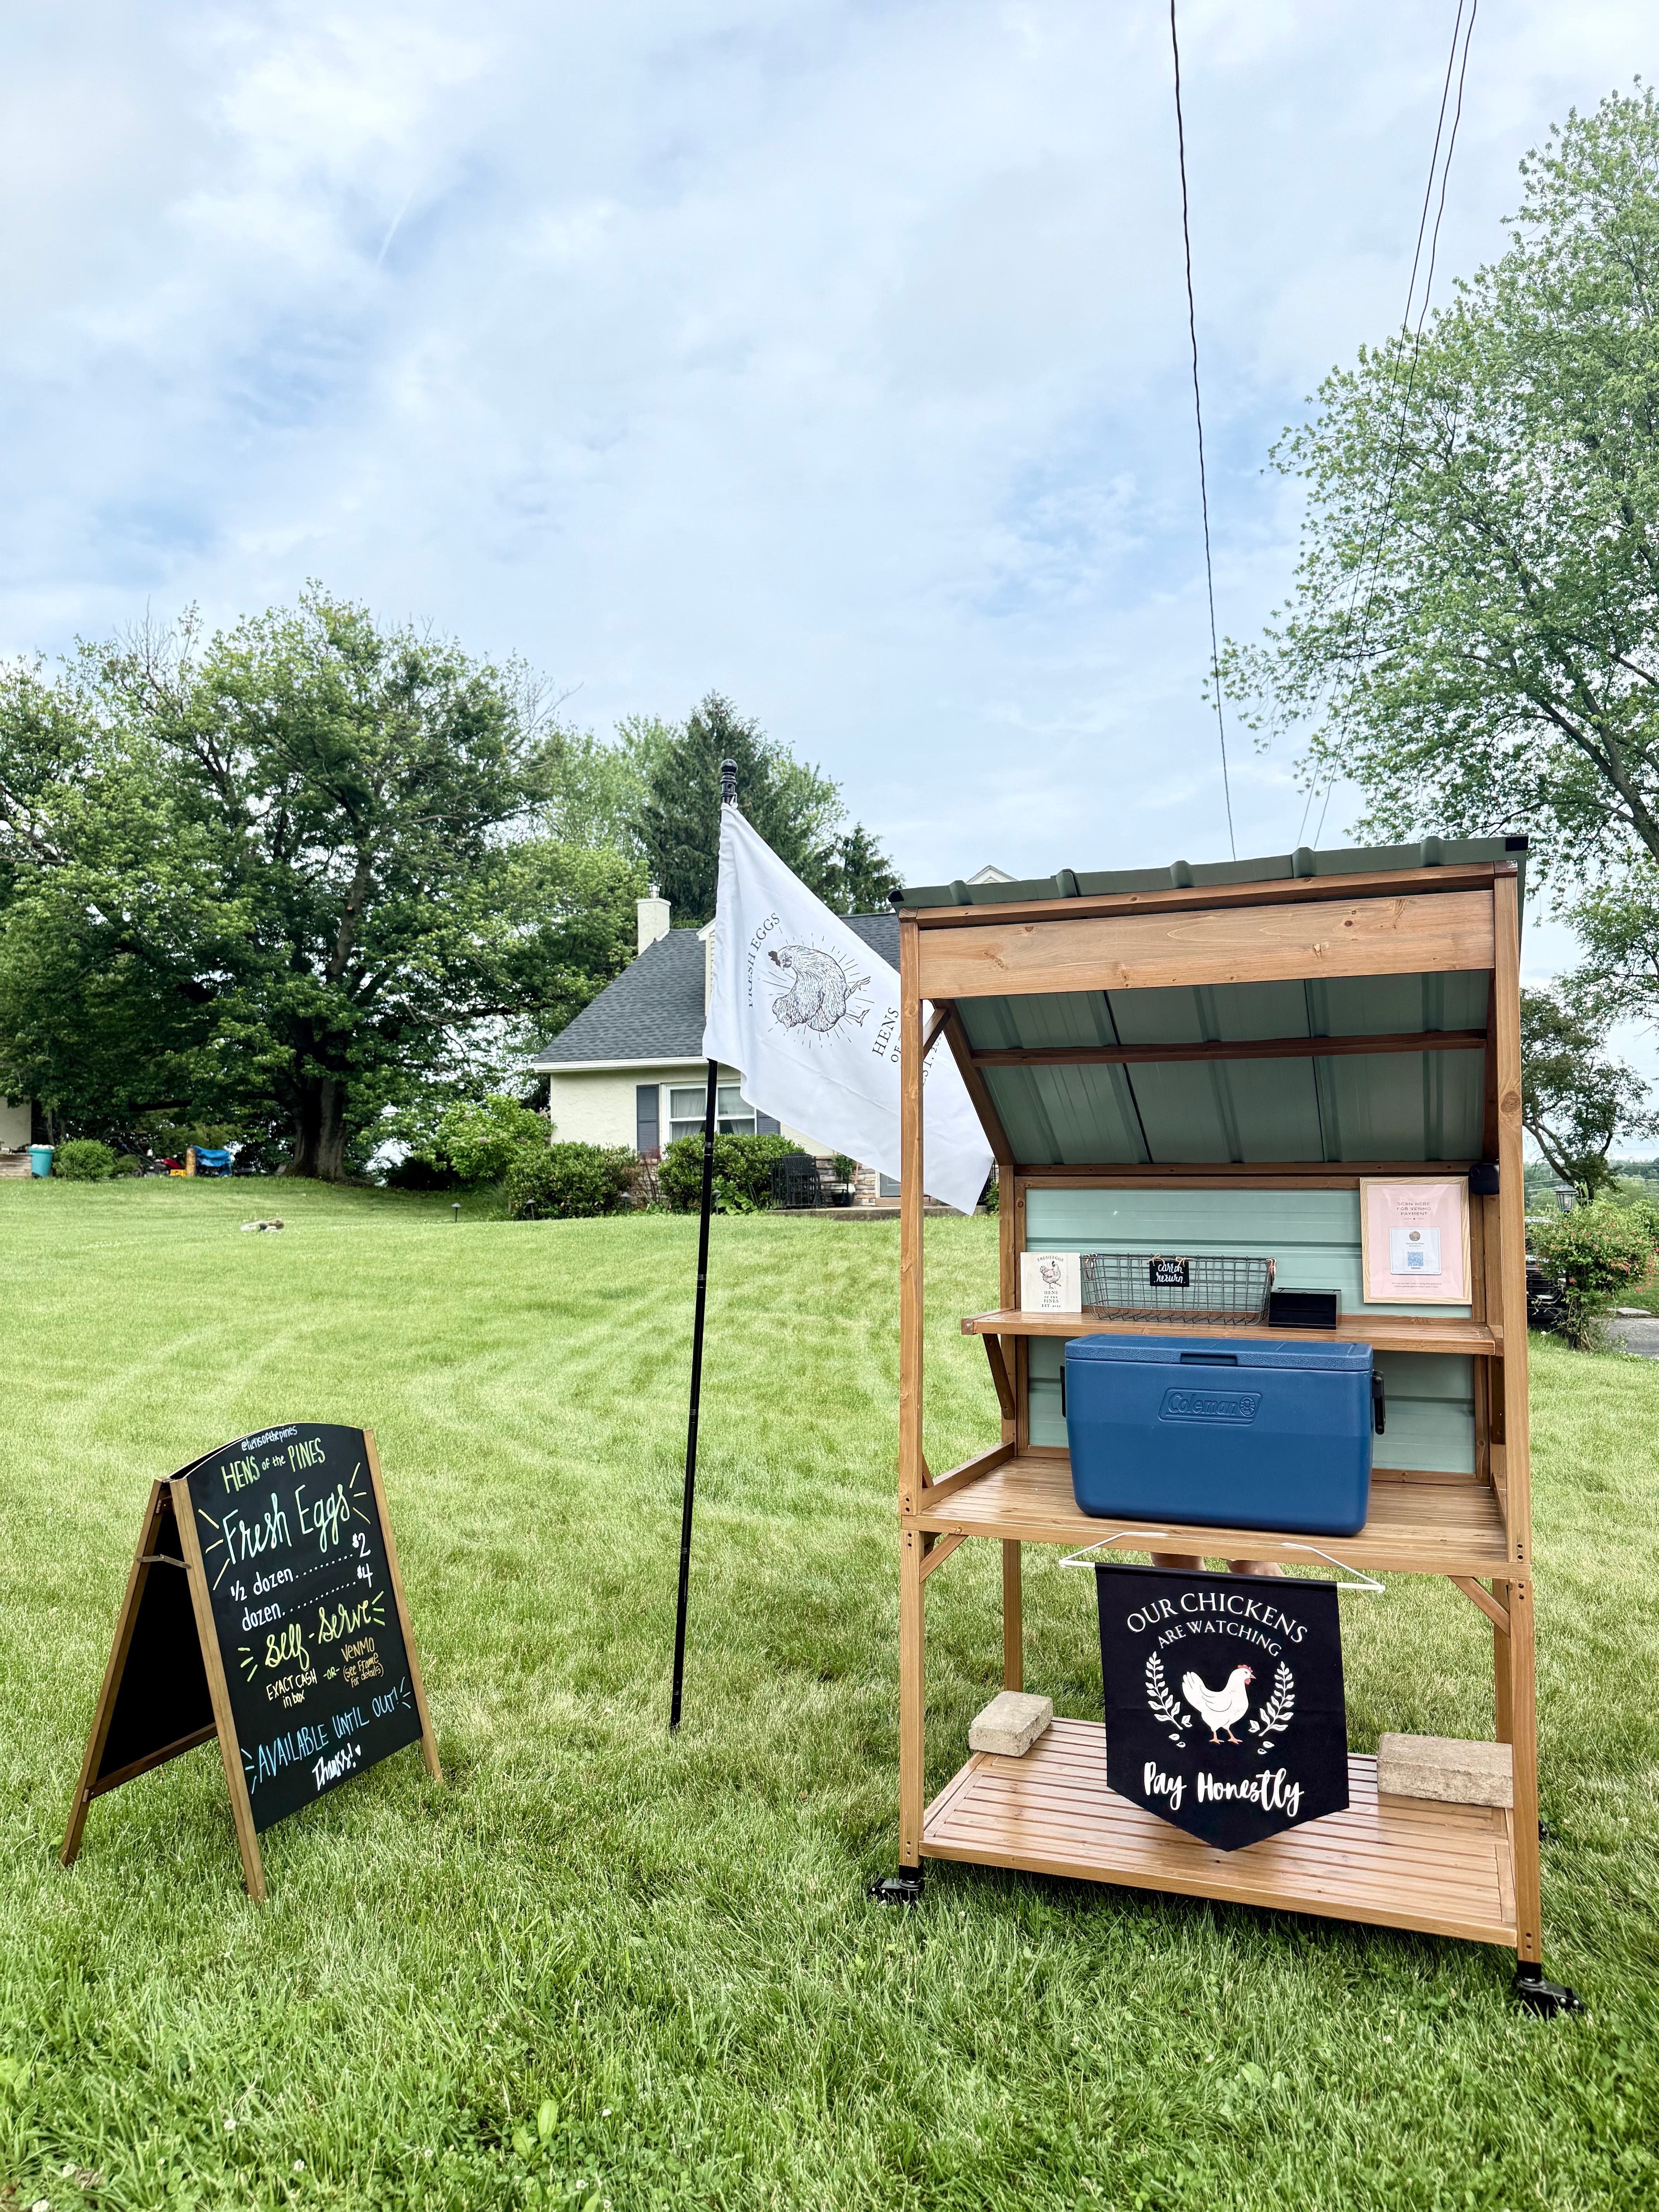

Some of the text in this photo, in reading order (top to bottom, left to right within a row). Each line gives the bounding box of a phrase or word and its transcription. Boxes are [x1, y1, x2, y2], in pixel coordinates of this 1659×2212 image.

[750, 913, 780, 951] EGGS
[872, 1007, 899, 1057] HENS
[1158, 1263, 1183, 1273] carton
[1168, 1393, 1238, 1415] Coleman
[241, 1425, 298, 1451] @hensofthepines
[221, 1437, 326, 1493] HENS of the PINES
[222, 1484, 350, 1564] Fresh Eggs
[352, 1532, 371, 1558] $2
[357, 1563, 373, 1588] $4
[1127, 1592, 1308, 1643] OUR CHICKENS
[1157, 1620, 1282, 1657] ARE WATCHING
[266, 1668, 317, 1701] EXACT CASH
[283, 1690, 305, 1708] in box
[258, 1686, 399, 1783] AVAILABLE UNTIL OUT!
[1144, 1761, 1305, 1817] Pay Honestly
